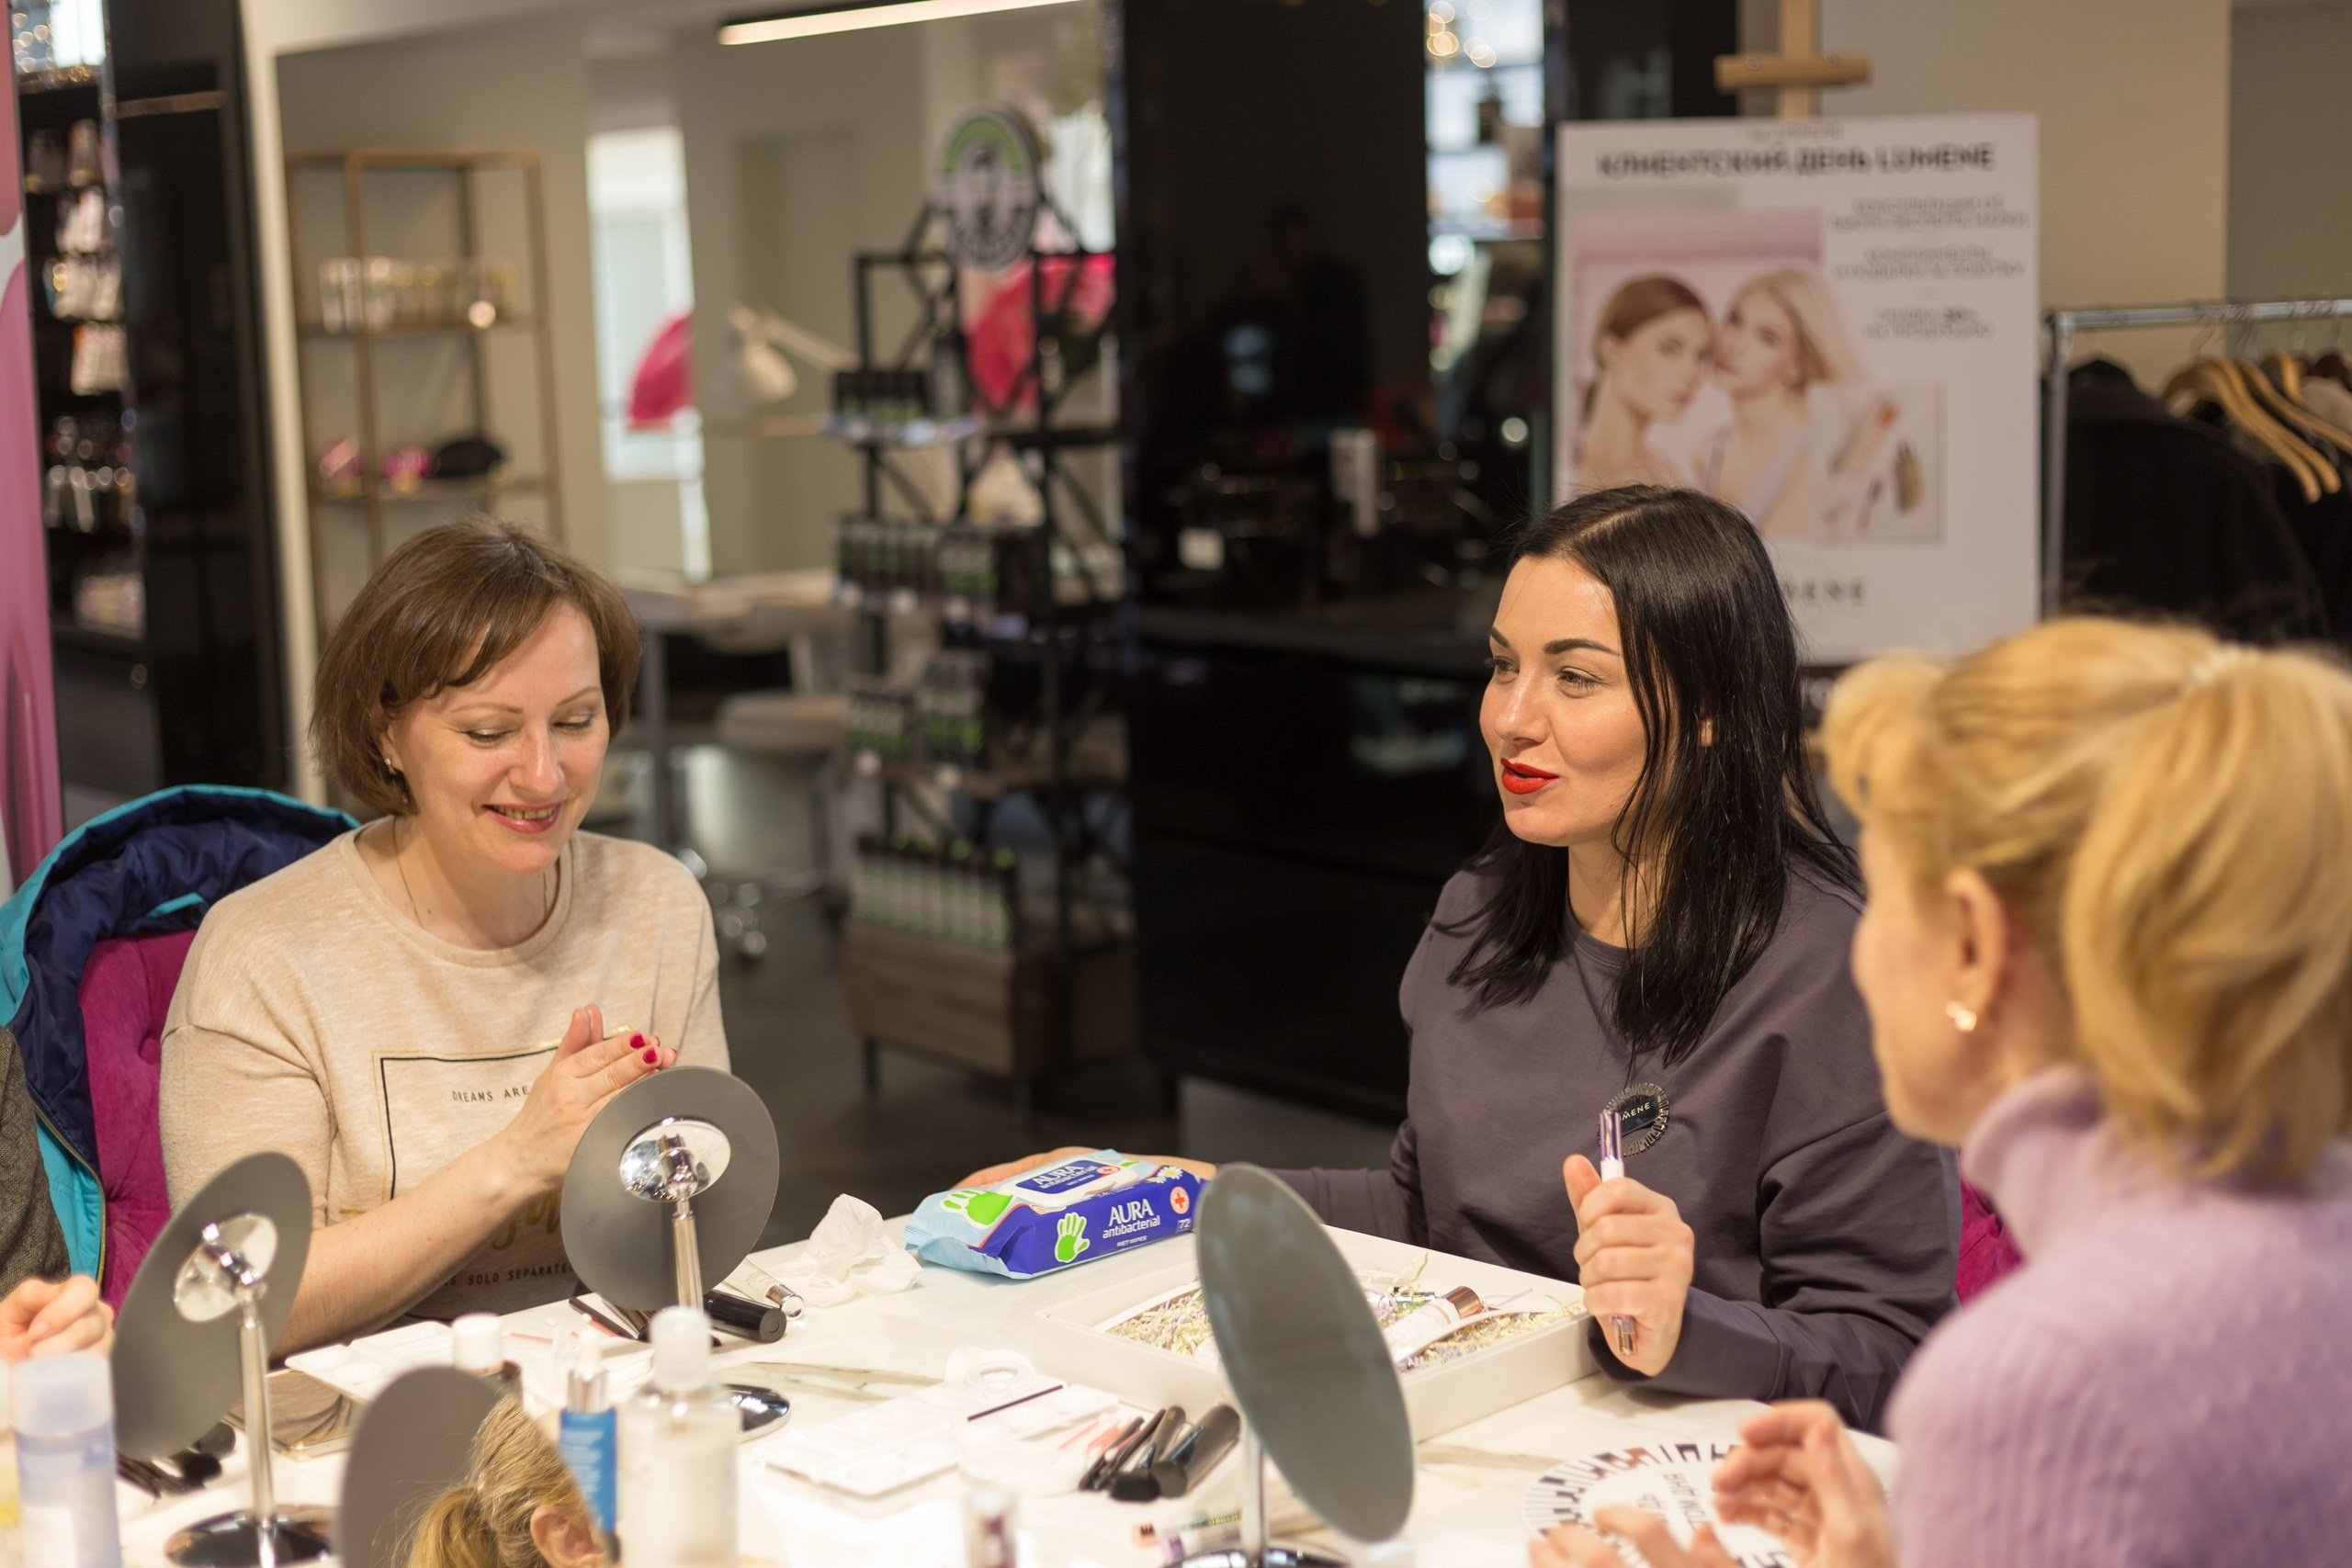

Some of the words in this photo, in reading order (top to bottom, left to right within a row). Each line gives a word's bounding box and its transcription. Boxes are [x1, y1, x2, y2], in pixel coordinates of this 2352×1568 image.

[1599, 146, 1789, 175] КЛИЕНТСКИЙ
[1797, 146, 1869, 175] ДЕНЬ
[1877, 142, 1995, 170] LUMENE
[451, 1090, 493, 1102] DREAMS
[503, 1086, 529, 1099] ARE
[1619, 1102, 1650, 1121] MENE
[1032, 1166, 1085, 1185] AURA
[1108, 1198, 1155, 1226] AURA
[1102, 1215, 1160, 1238] antibacterial
[468, 1272, 500, 1285] SOLD
